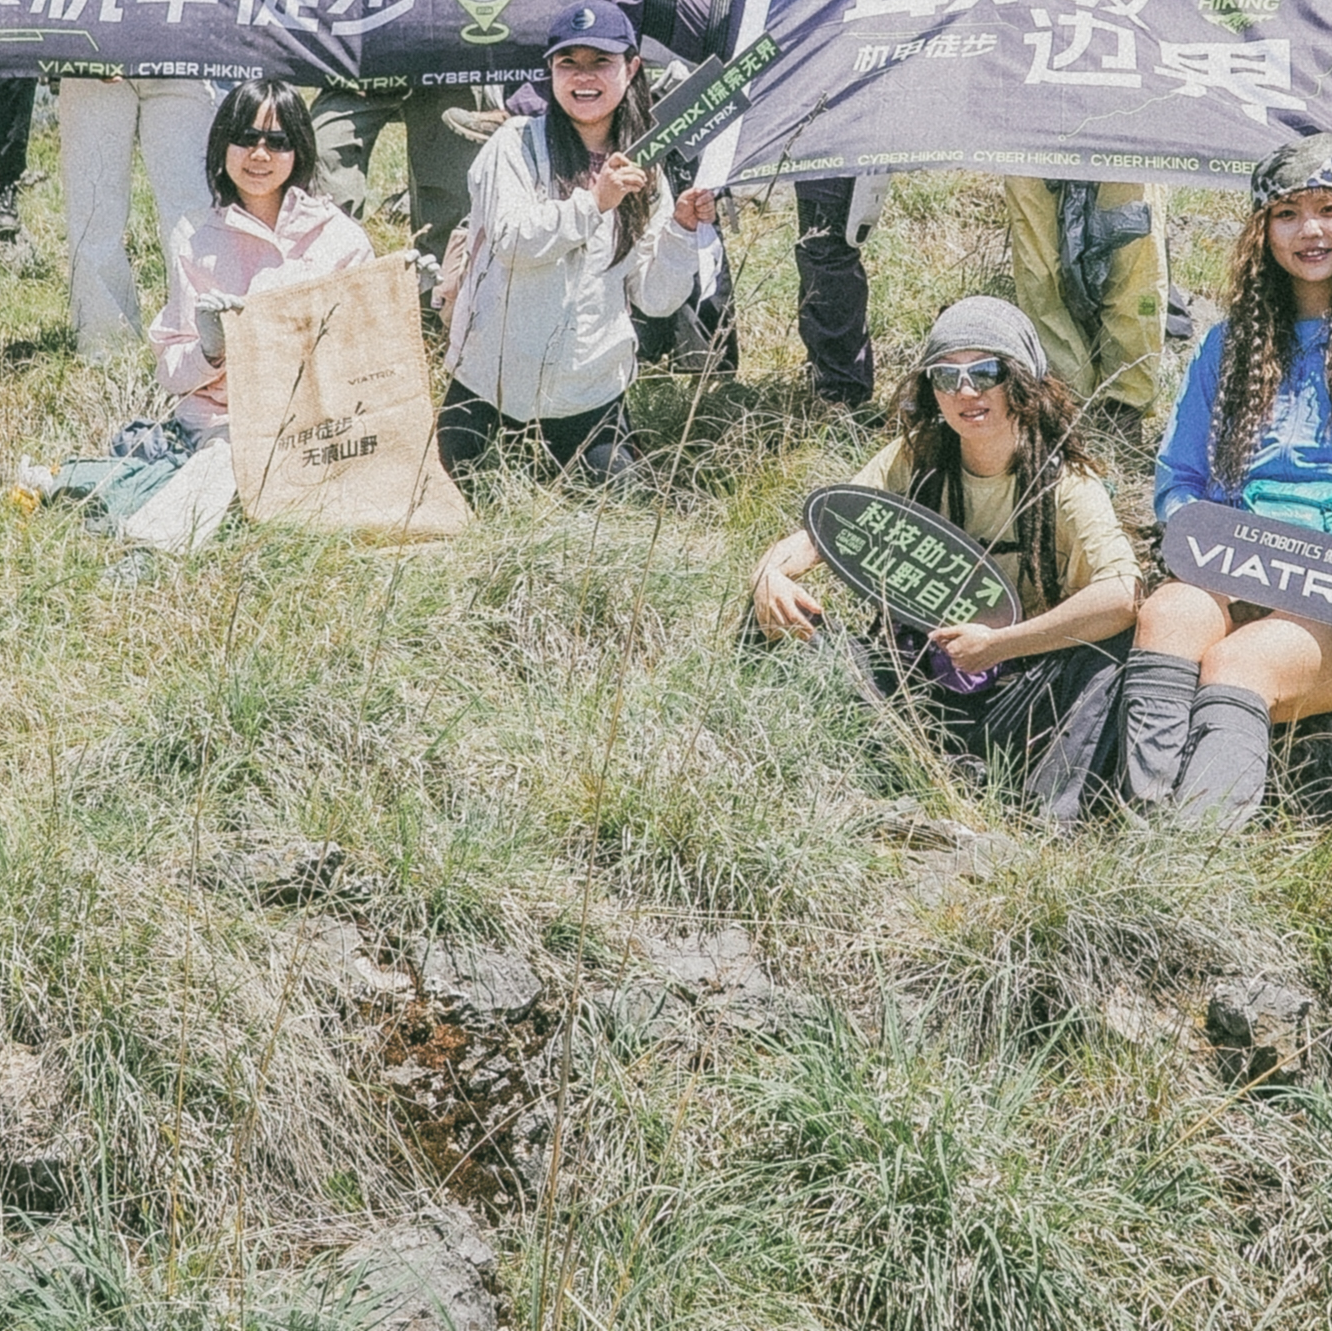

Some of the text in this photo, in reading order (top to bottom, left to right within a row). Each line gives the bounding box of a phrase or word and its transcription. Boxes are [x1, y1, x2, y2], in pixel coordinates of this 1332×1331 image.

[38, 60, 264, 80] VIATRIX CYBER HIKING
[853, 33, 998, 72] 机甲徒步
[1023, 8, 1307, 126] 边界
[325, 74, 408, 90] VIATRIX
[422, 70, 481, 85] CYBER
[636, 38, 777, 168] VIATRIX 探索无界
[684, 100, 738, 148] VIATRIX
[740, 162, 791, 180] CYBER
[791, 157, 844, 173] HIKING
[858, 152, 909, 166] CYBER
[910, 150, 964, 162] HIKING
[973, 150, 1025, 164] CYBER
[1027, 151, 1080, 165] HIKING
[1090, 154, 1143, 168] CYBER
[1144, 155, 1199, 170] HIKING
[348, 369, 396, 385] VIATRIX
[278, 417, 353, 450] 机甲徒步
[856, 501, 974, 585] 科技助力
[1233, 524, 1261, 542] ULS
[1259, 531, 1323, 559] ROBOTICS
[860, 546, 978, 626] 山野自由
